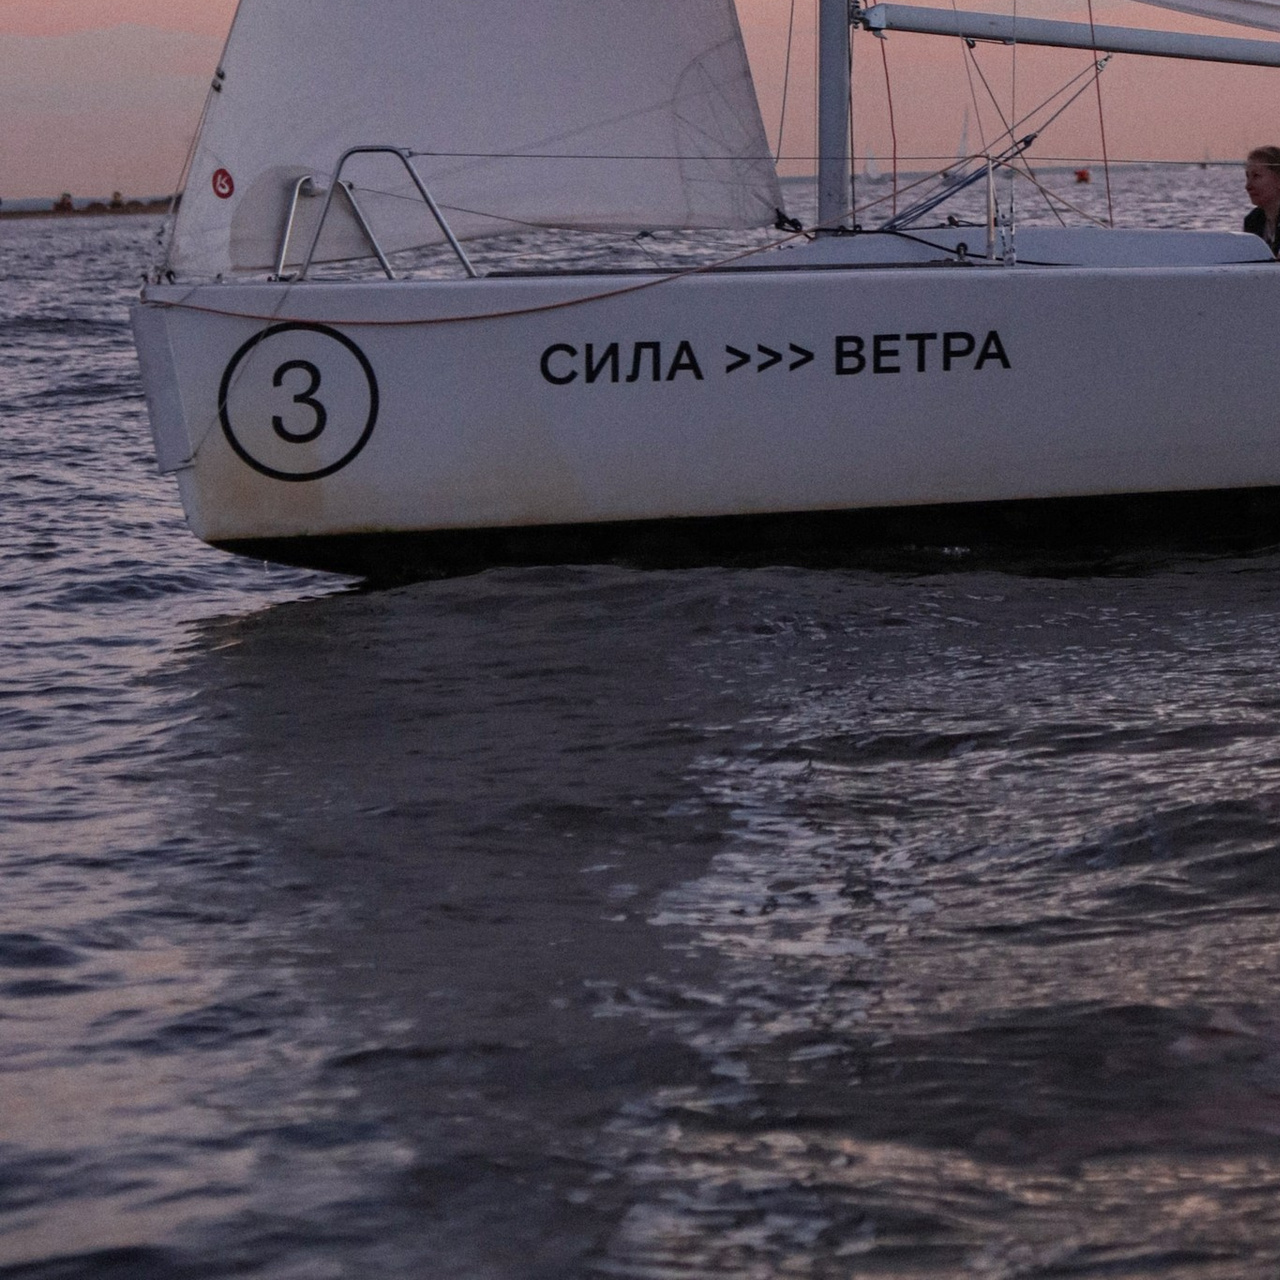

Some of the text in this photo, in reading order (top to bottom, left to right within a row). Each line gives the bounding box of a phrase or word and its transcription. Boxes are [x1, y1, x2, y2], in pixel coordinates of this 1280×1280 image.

[540, 341, 703, 385] СИЛА
[835, 330, 1011, 375] ВЕТРА
[272, 360, 327, 444] 3
